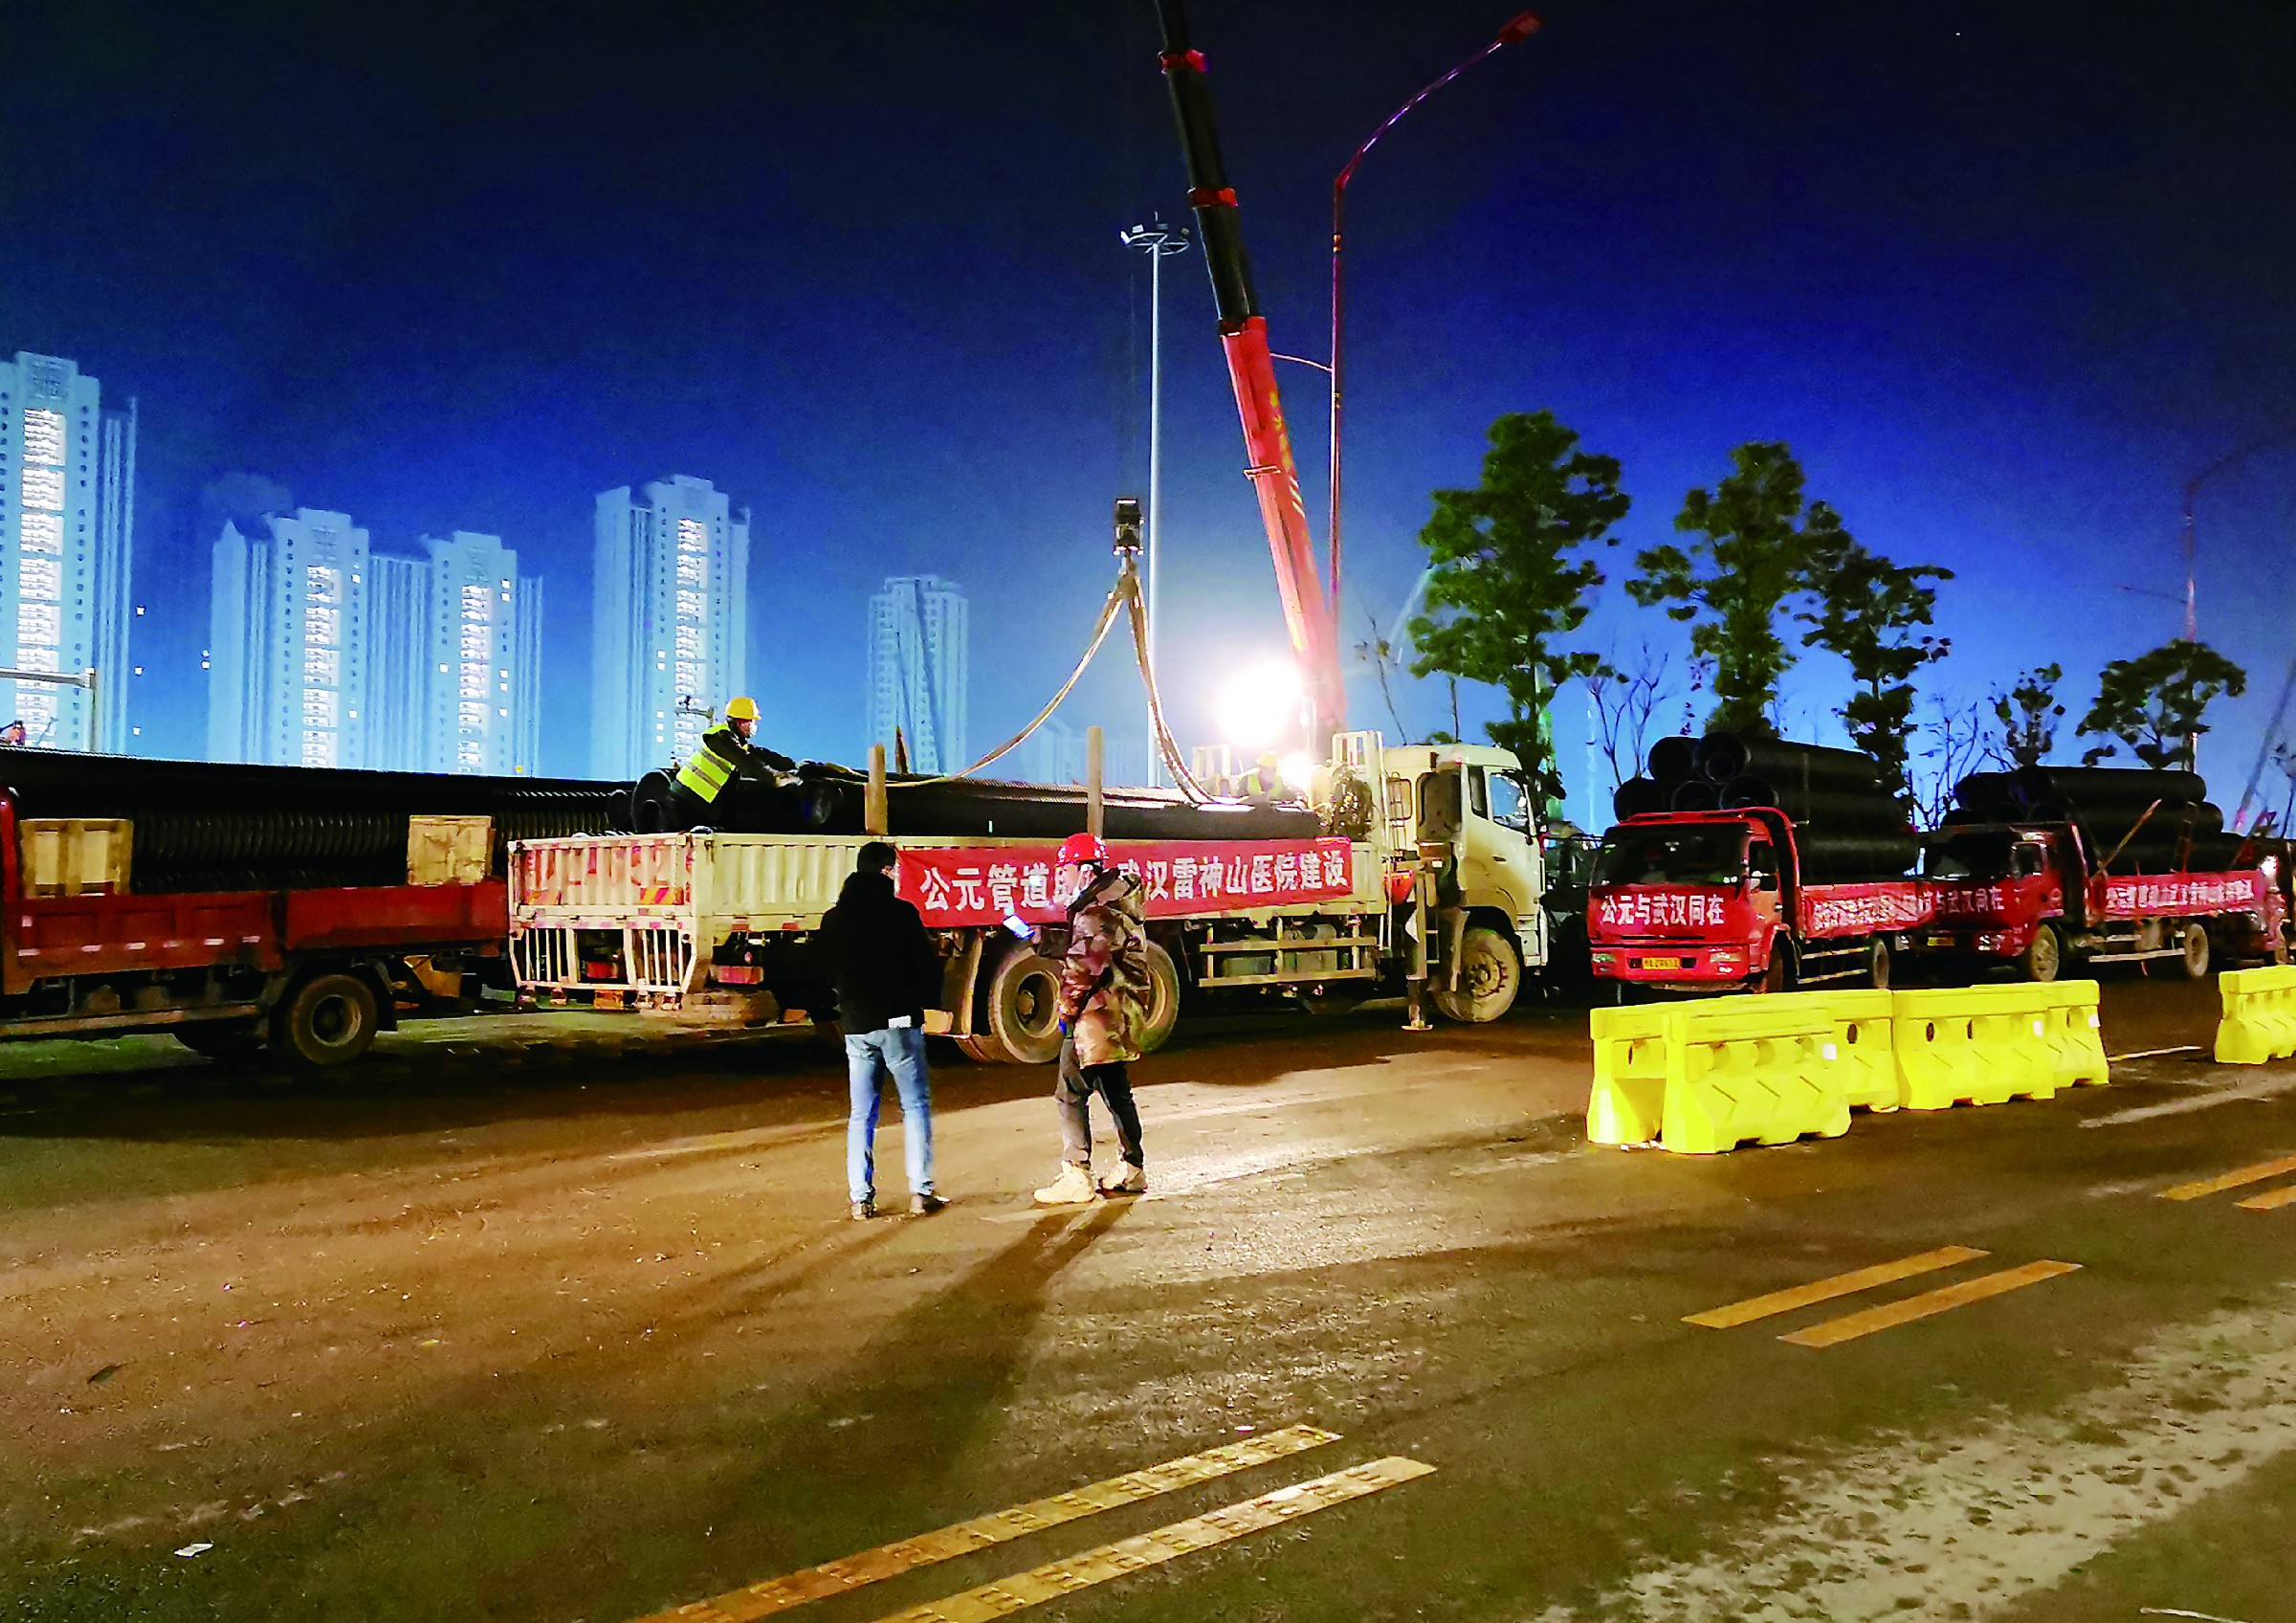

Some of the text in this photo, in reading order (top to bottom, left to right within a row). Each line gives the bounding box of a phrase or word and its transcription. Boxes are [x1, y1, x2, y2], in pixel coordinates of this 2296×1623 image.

[1601, 893, 1725, 926] 公元与武汉同在
